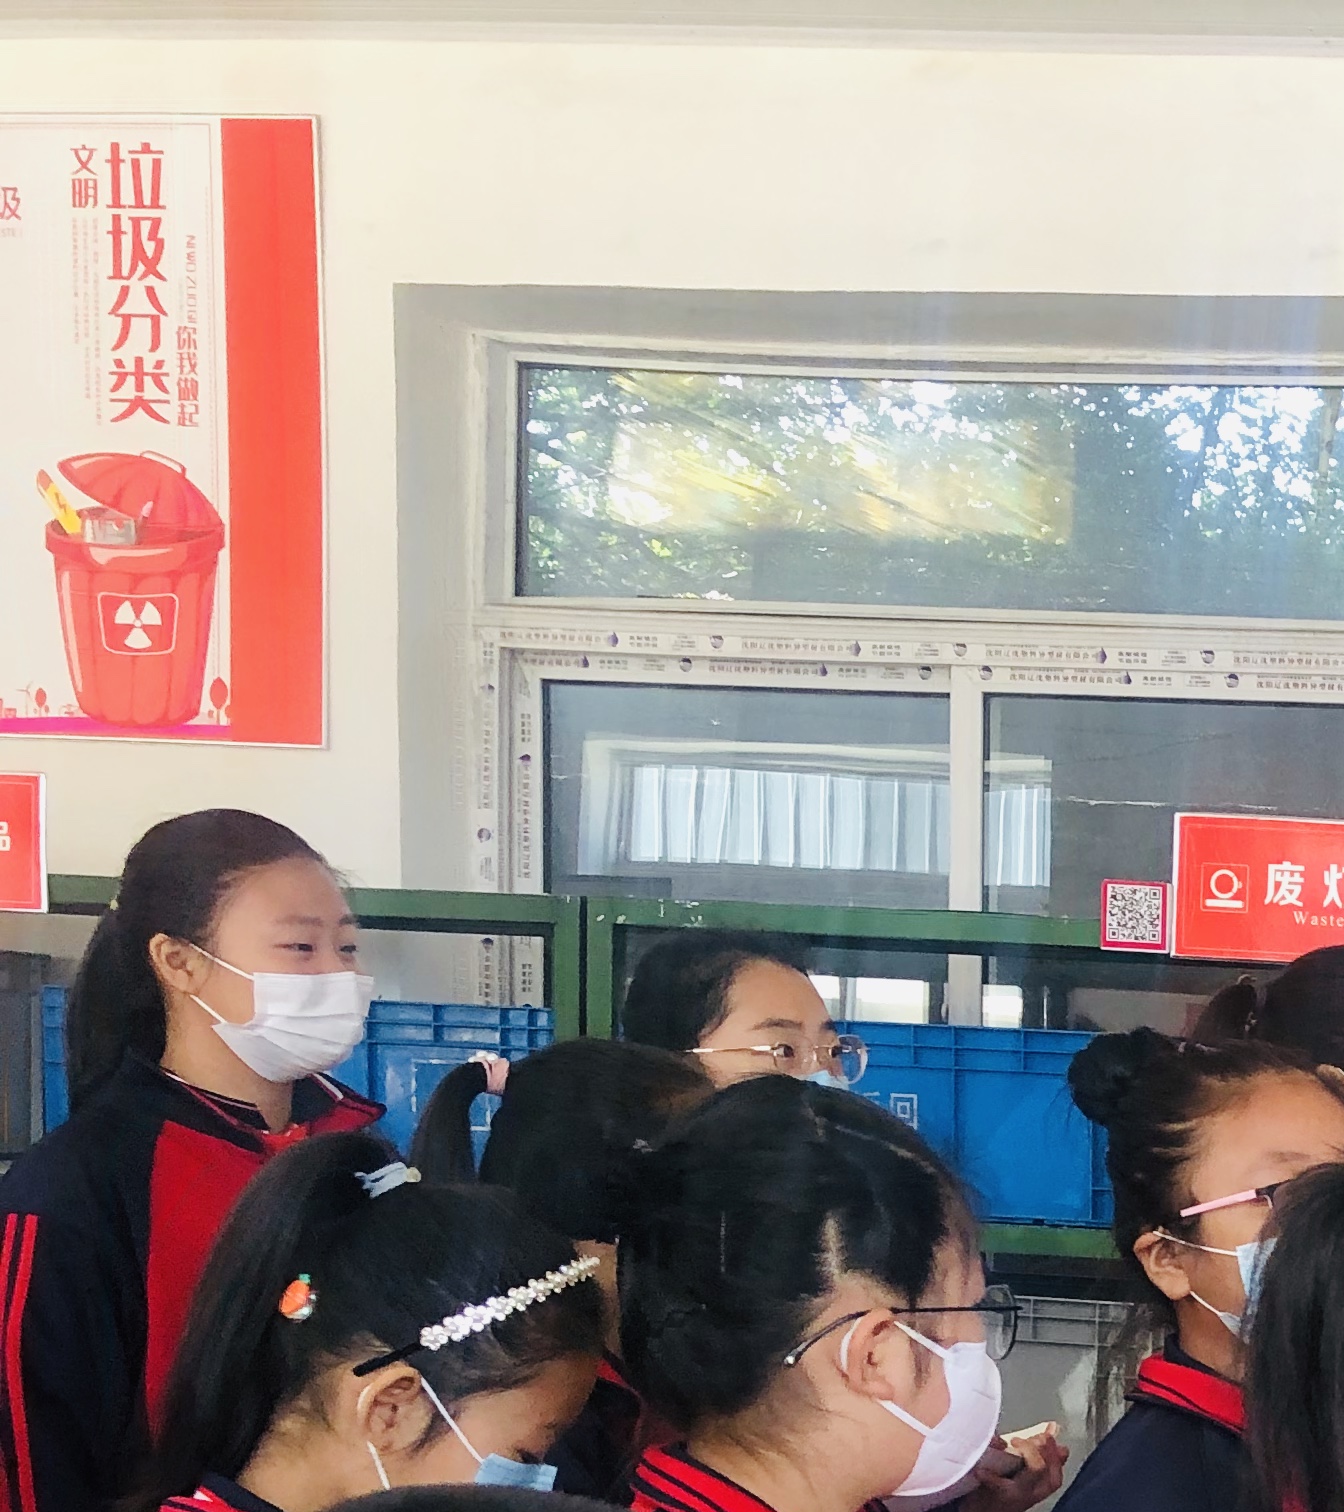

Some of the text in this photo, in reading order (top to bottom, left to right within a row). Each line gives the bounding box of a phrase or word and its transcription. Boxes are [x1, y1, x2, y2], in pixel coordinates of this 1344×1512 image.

[70, 144, 99, 209] 文明
[104, 141, 171, 425] 垃圾分类
[175, 325, 200, 427] 你我做起
[1293, 911, 1344, 927] Waste
